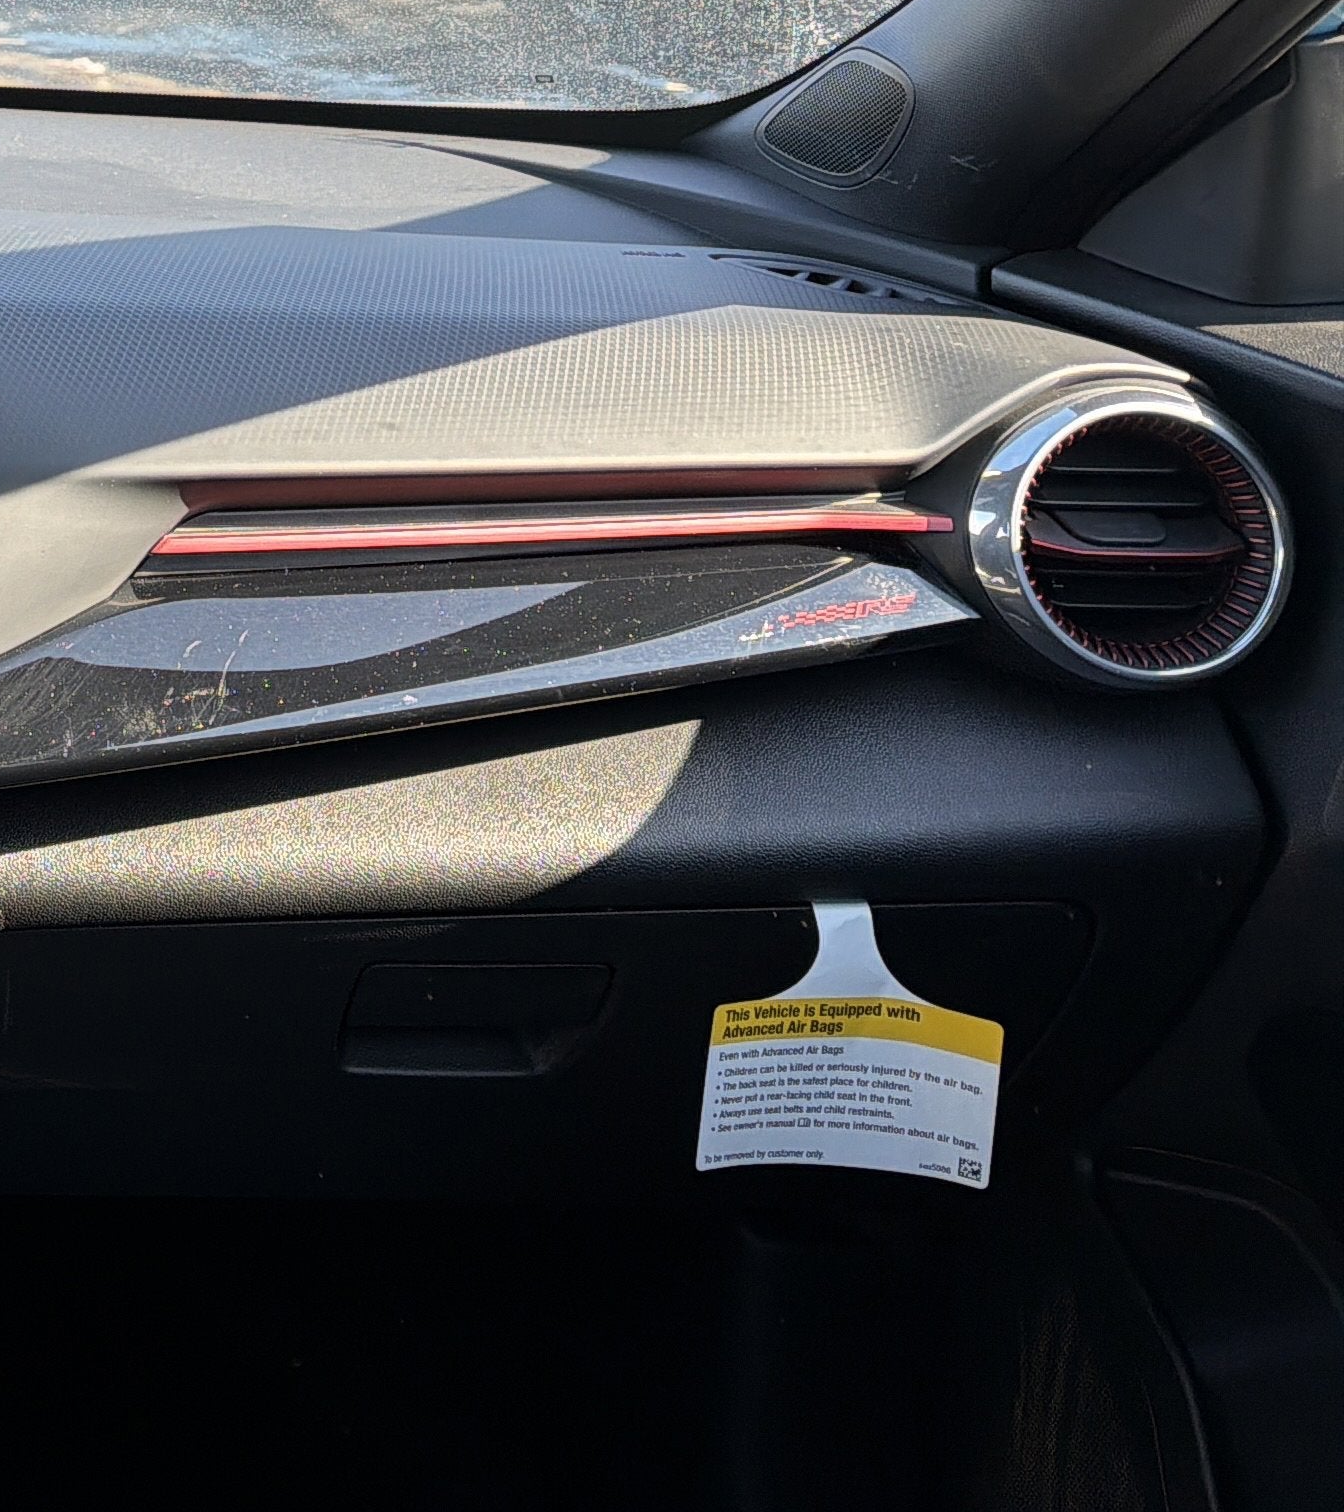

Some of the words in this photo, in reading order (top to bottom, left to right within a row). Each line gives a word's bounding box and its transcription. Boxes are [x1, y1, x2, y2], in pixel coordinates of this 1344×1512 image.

[725, 1008, 750, 1023] This
[753, 1004, 800, 1020] Vehicle
[803, 1003, 815, 1017] is
[819, 1003, 882, 1019] Equipped
[887, 1005, 921, 1022] with
[722, 1021, 784, 1039] Advanced
[787, 1020, 807, 1034] Air
[810, 1020, 844, 1035] Bags
[719, 1051, 740, 1062] Even
[741, 1048, 759, 1059] with
[761, 1046, 804, 1057] Advanced
[806, 1045, 819, 1055] Air
[821, 1045, 844, 1056] Bags
[723, 1067, 758, 1078] Children
[759, 1064, 774, 1074] can
[776, 1063, 788, 1073] be
[789, 1063, 814, 1073] killed
[826, 1063, 869, 1075] seriously
[871, 1064, 906, 1077] injured
[908, 1068, 921, 1080] by
[924, 1072, 941, 1084] the
[943, 1077, 958, 1088] air
[960, 1080, 983, 1095] bag.
[723, 1081, 737, 1091] The
[738, 1079, 757, 1089] back
[758, 1078, 776, 1088] seat
[778, 1077, 785, 1086] is
[787, 1076, 801, 1086] the
[802, 1076, 828, 1086] safest
[829, 1076, 854, 1087] place
[857, 1077, 869, 1088] for
[871, 1078, 913, 1093] children.
[720, 1095, 743, 1105] Never
[744, 1093, 758, 1104] put
[766, 1090, 812, 1101] rear-facing
[814, 1090, 835, 1100] child
[837, 1091, 857, 1102] seat
[858, 1092, 867, 1103] in
[869, 1092, 885, 1104] the
[887, 1094, 912, 1107] front.
[719, 1108, 746, 1118] Always
[747, 1107, 763, 1116] use
[764, 1105, 781, 1115] seat
[783, 1105, 804, 1114] belts
[805, 1105, 822, 1114] and
[823, 1105, 846, 1115] child
[847, 1107, 895, 1120] restraints.
[717, 1123, 731, 1133] See
[733, 1119, 764, 1131] owner's
[765, 1118, 795, 1128] manual
[813, 1118, 825, 1128] for
[827, 1120, 851, 1130] more
[852, 1120, 905, 1136] information
[907, 1127, 935, 1140] about
[937, 1133, 951, 1143] air
[952, 1135, 979, 1151] bags.
[704, 1155, 713, 1164] To
[713, 1153, 723, 1163] be
[724, 1149, 755, 1161] removed
[756, 1149, 767, 1160] by
[767, 1149, 804, 1159] customer
[806, 1149, 825, 1161] only.
